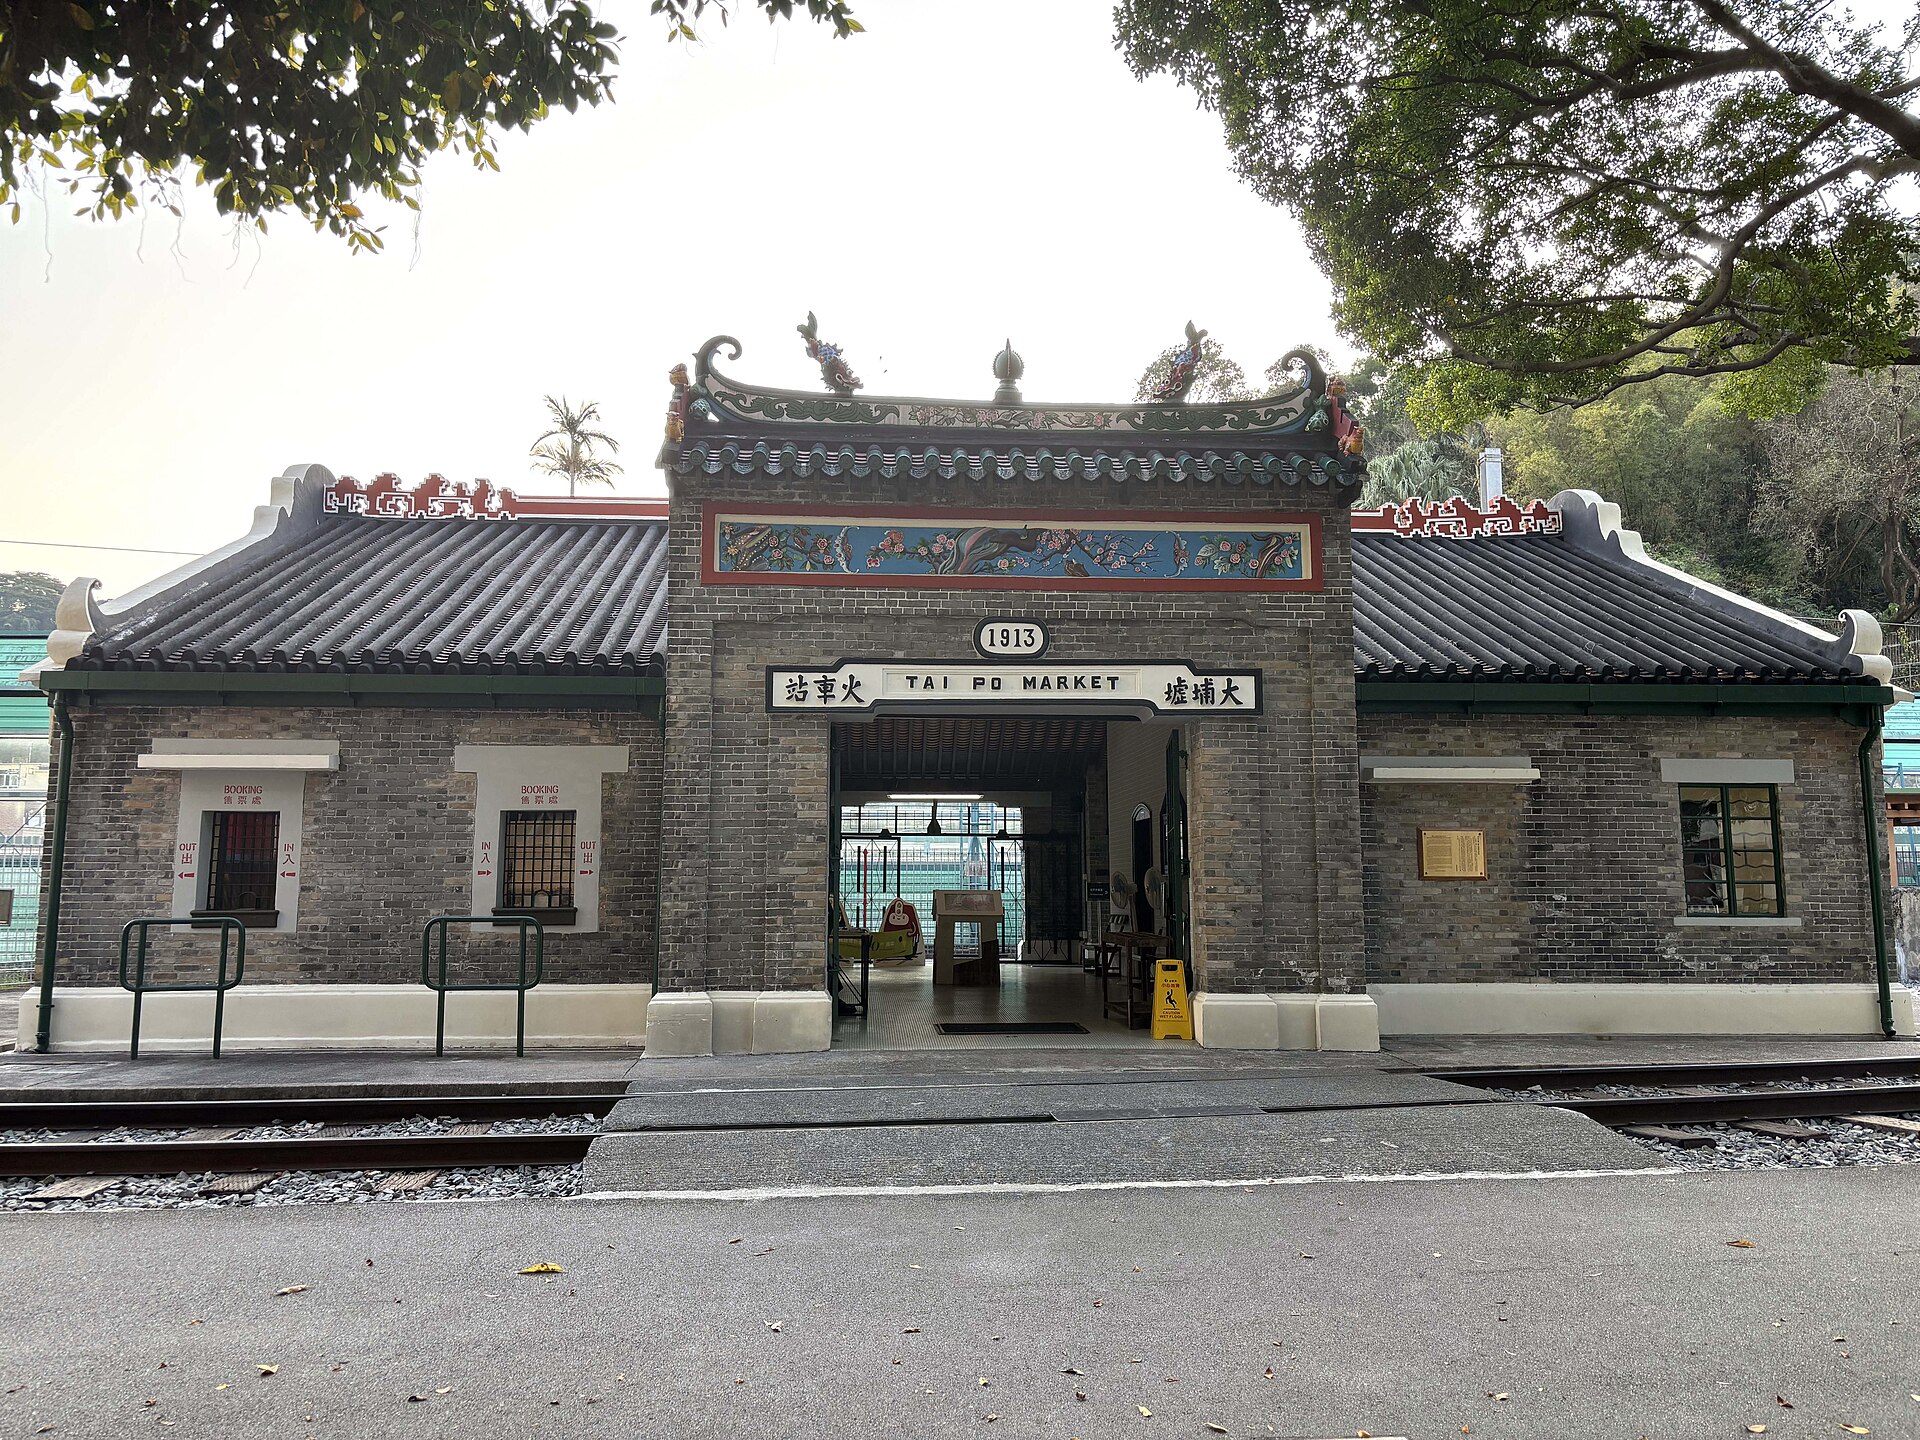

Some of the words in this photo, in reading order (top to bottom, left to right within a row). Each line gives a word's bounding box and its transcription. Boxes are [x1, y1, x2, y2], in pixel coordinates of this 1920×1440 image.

[987, 628, 1037, 648] 1913
[905, 675, 949, 690] TAI
[972, 676, 1002, 690] PO
[1022, 676, 1120, 690] MARKET
[224, 785, 263, 794] BOOKING
[521, 785, 559, 794] BOOKING
[179, 843, 197, 851] OUT
[283, 843, 295, 852] IN
[481, 841, 491, 850] IN
[580, 841, 597, 850] OUT
[181, 853, 193, 865] 出
[282, 853, 295, 865] 入
[480, 852, 491, 864] 入
[583, 852, 593, 864] 出
